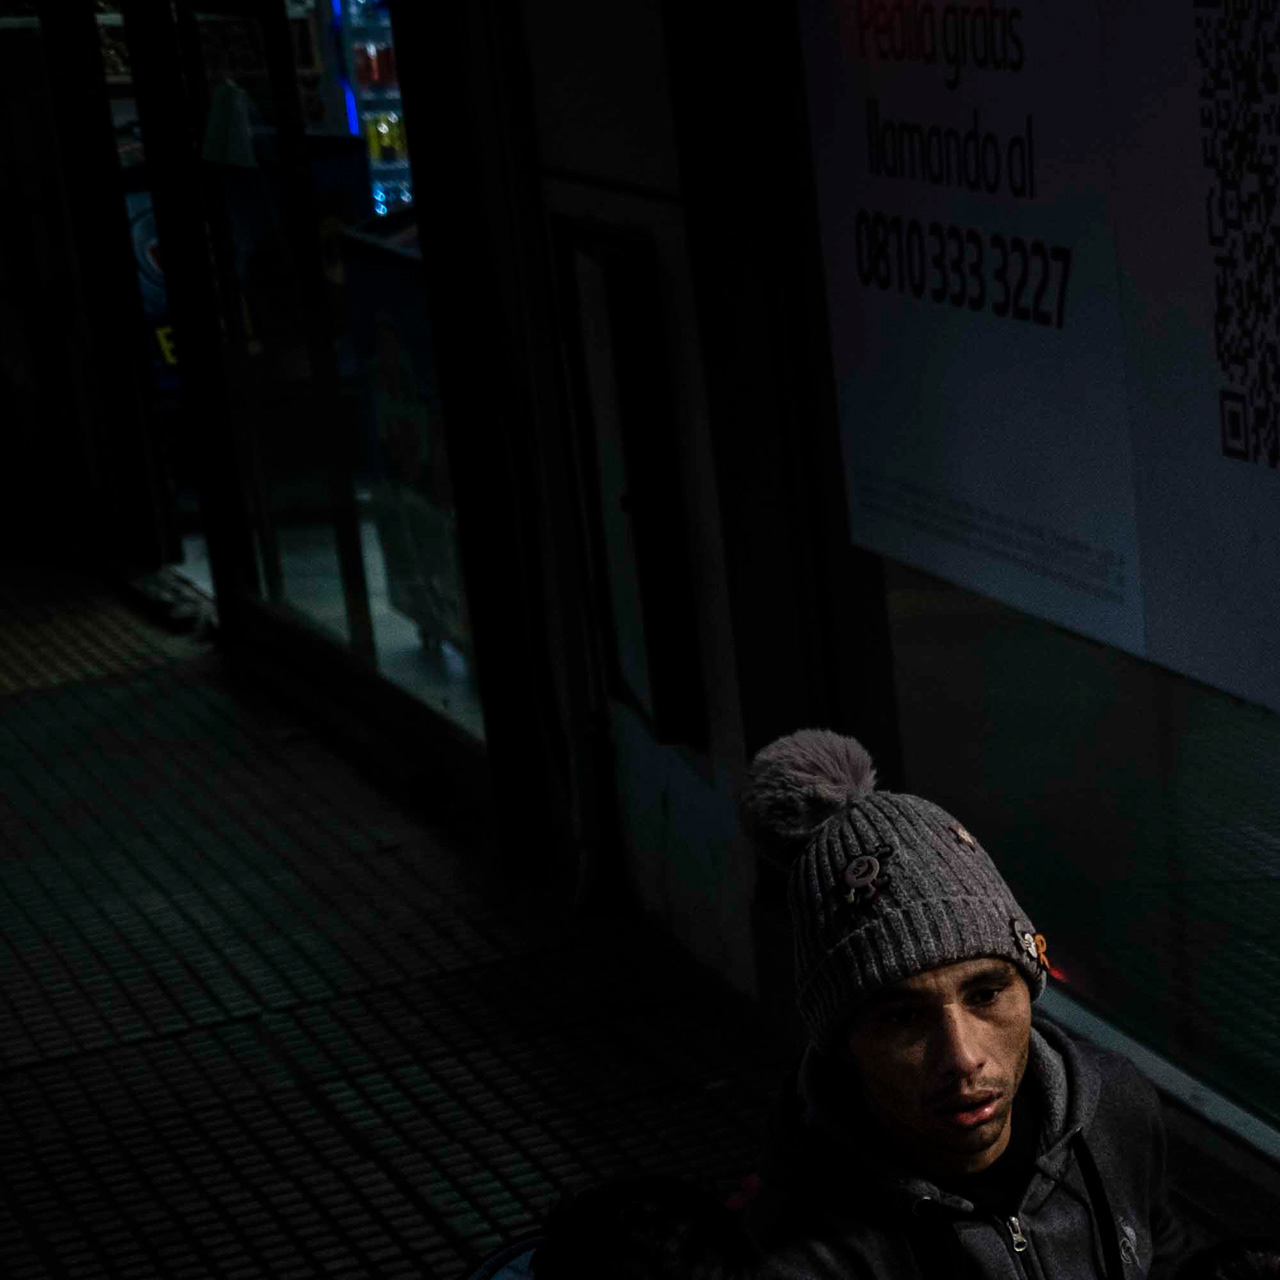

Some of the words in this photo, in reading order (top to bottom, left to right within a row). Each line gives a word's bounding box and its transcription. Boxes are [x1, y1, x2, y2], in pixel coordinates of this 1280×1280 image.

[943, 0, 1024, 90] gratis
[866, 97, 1000, 194] llamando
[1008, 113, 1034, 199] al
[856, 210, 925, 299] 0810
[928, 221, 986, 311] 333
[991, 233, 1071, 329] 3227
